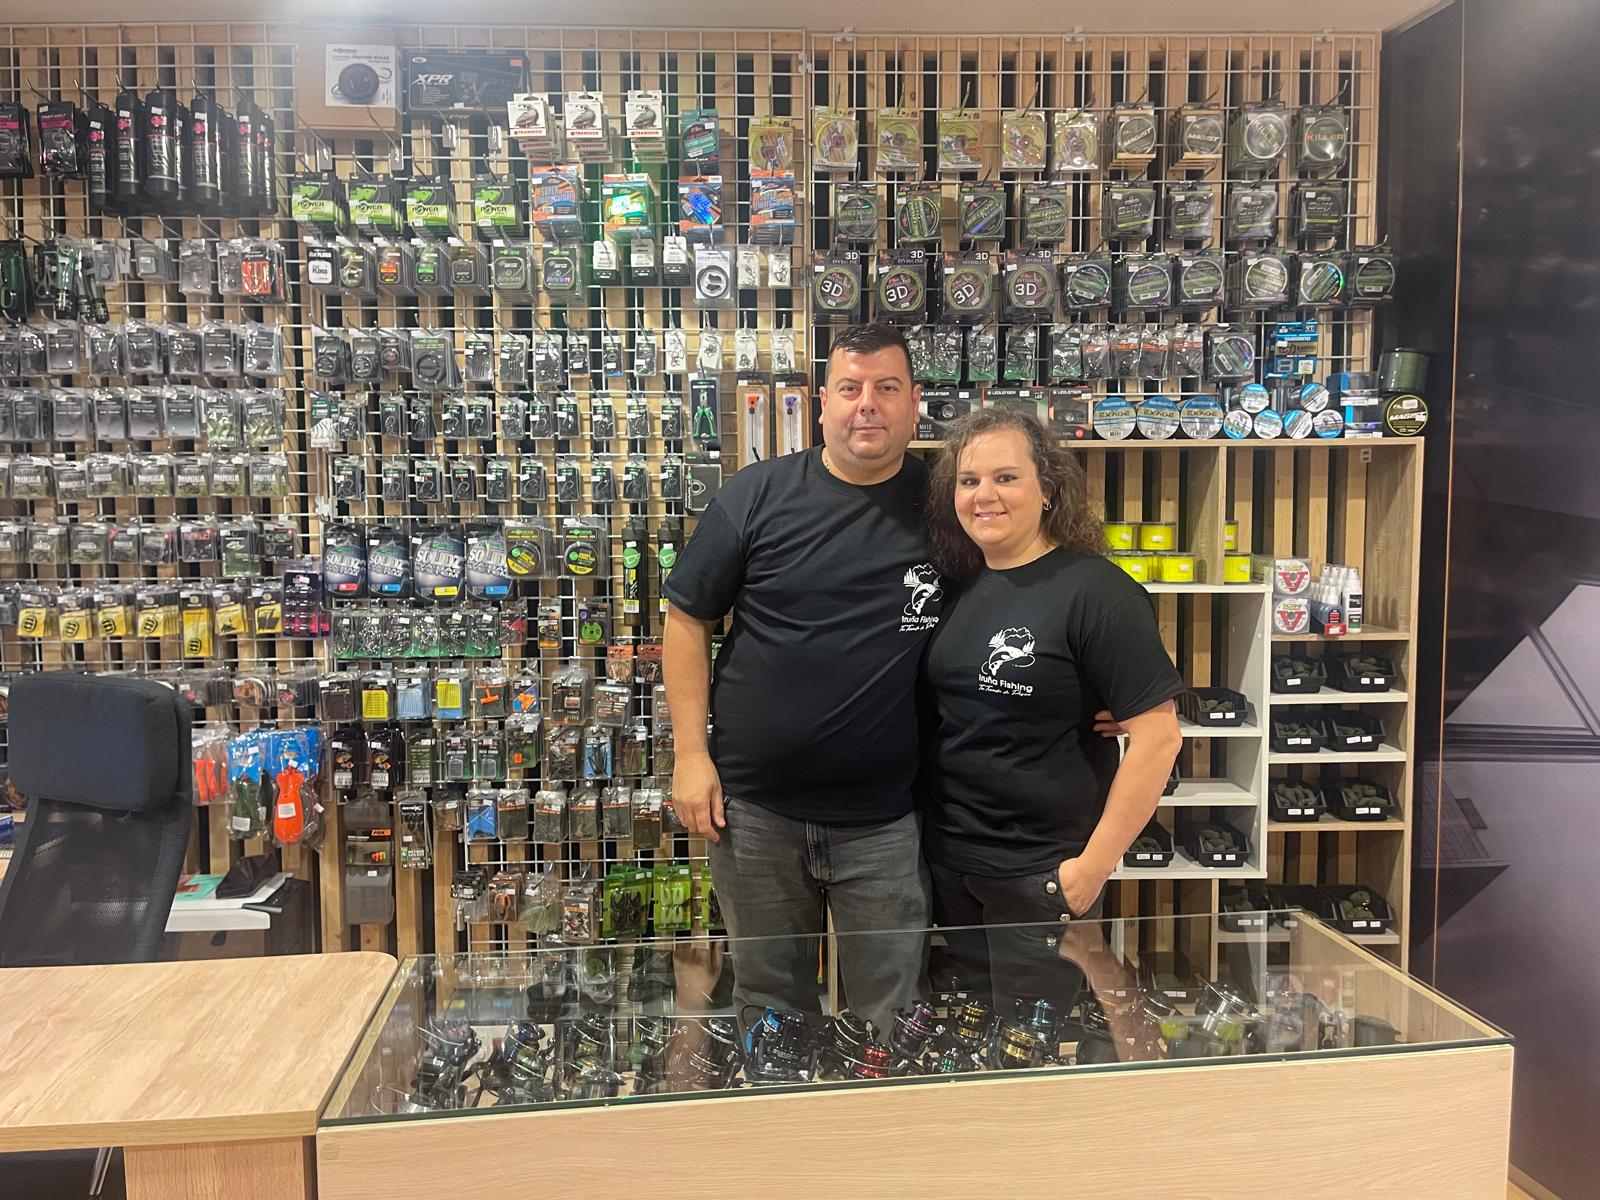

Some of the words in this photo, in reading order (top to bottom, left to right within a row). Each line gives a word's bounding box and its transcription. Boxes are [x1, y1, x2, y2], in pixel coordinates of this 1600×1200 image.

[411, 73, 454, 85] XPR
[1307, 133, 1344, 141] KILLER
[297, 200, 325, 209] POWER
[355, 203, 383, 212] POWER
[412, 205, 439, 214] POWER
[480, 205, 507, 214] POWER
[845, 252, 859, 260] 3D
[910, 250, 924, 258] 3D
[975, 252, 989, 260] 3D
[1038, 250, 1051, 258] 3D
[821, 280, 843, 297] 3D
[1015, 283, 1037, 296] 3D
[886, 285, 908, 302] 3D
[954, 284, 975, 304] 3D
[1277, 358, 1293, 373] 8
[1098, 410, 1130, 418] EXAGE
[1143, 409, 1175, 418] EXAGE
[177, 475, 205, 483] MUGGA
[213, 473, 240, 482] MUGGA
[325, 553, 361, 570] SOLIDZ
[369, 553, 404, 570] SOLIDZ
[415, 550, 462, 569] SOLIDZ
[978, 673, 999, 686] Iruña
[1000, 679, 1034, 694] Fishing
